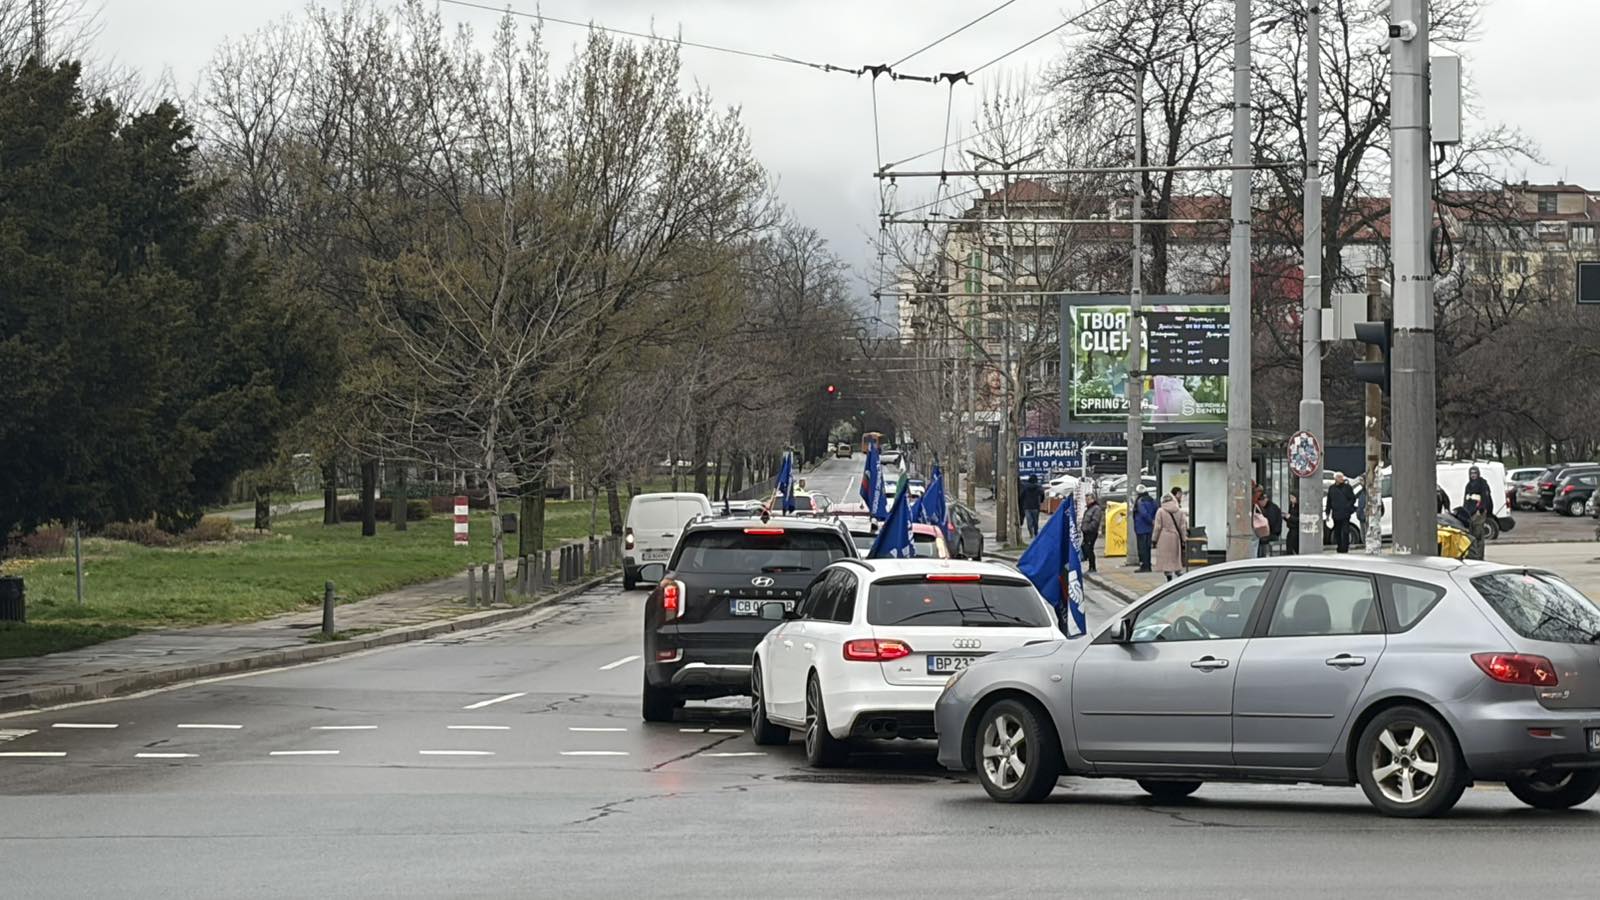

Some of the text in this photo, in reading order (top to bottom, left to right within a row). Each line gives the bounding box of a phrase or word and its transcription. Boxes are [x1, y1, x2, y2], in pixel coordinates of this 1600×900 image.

[1081, 398, 1119, 409] SPRING
[1037, 441, 1079, 450] ПЛАТЕН
[738, 601, 751, 611] CB
[936, 657, 952, 669] BP
